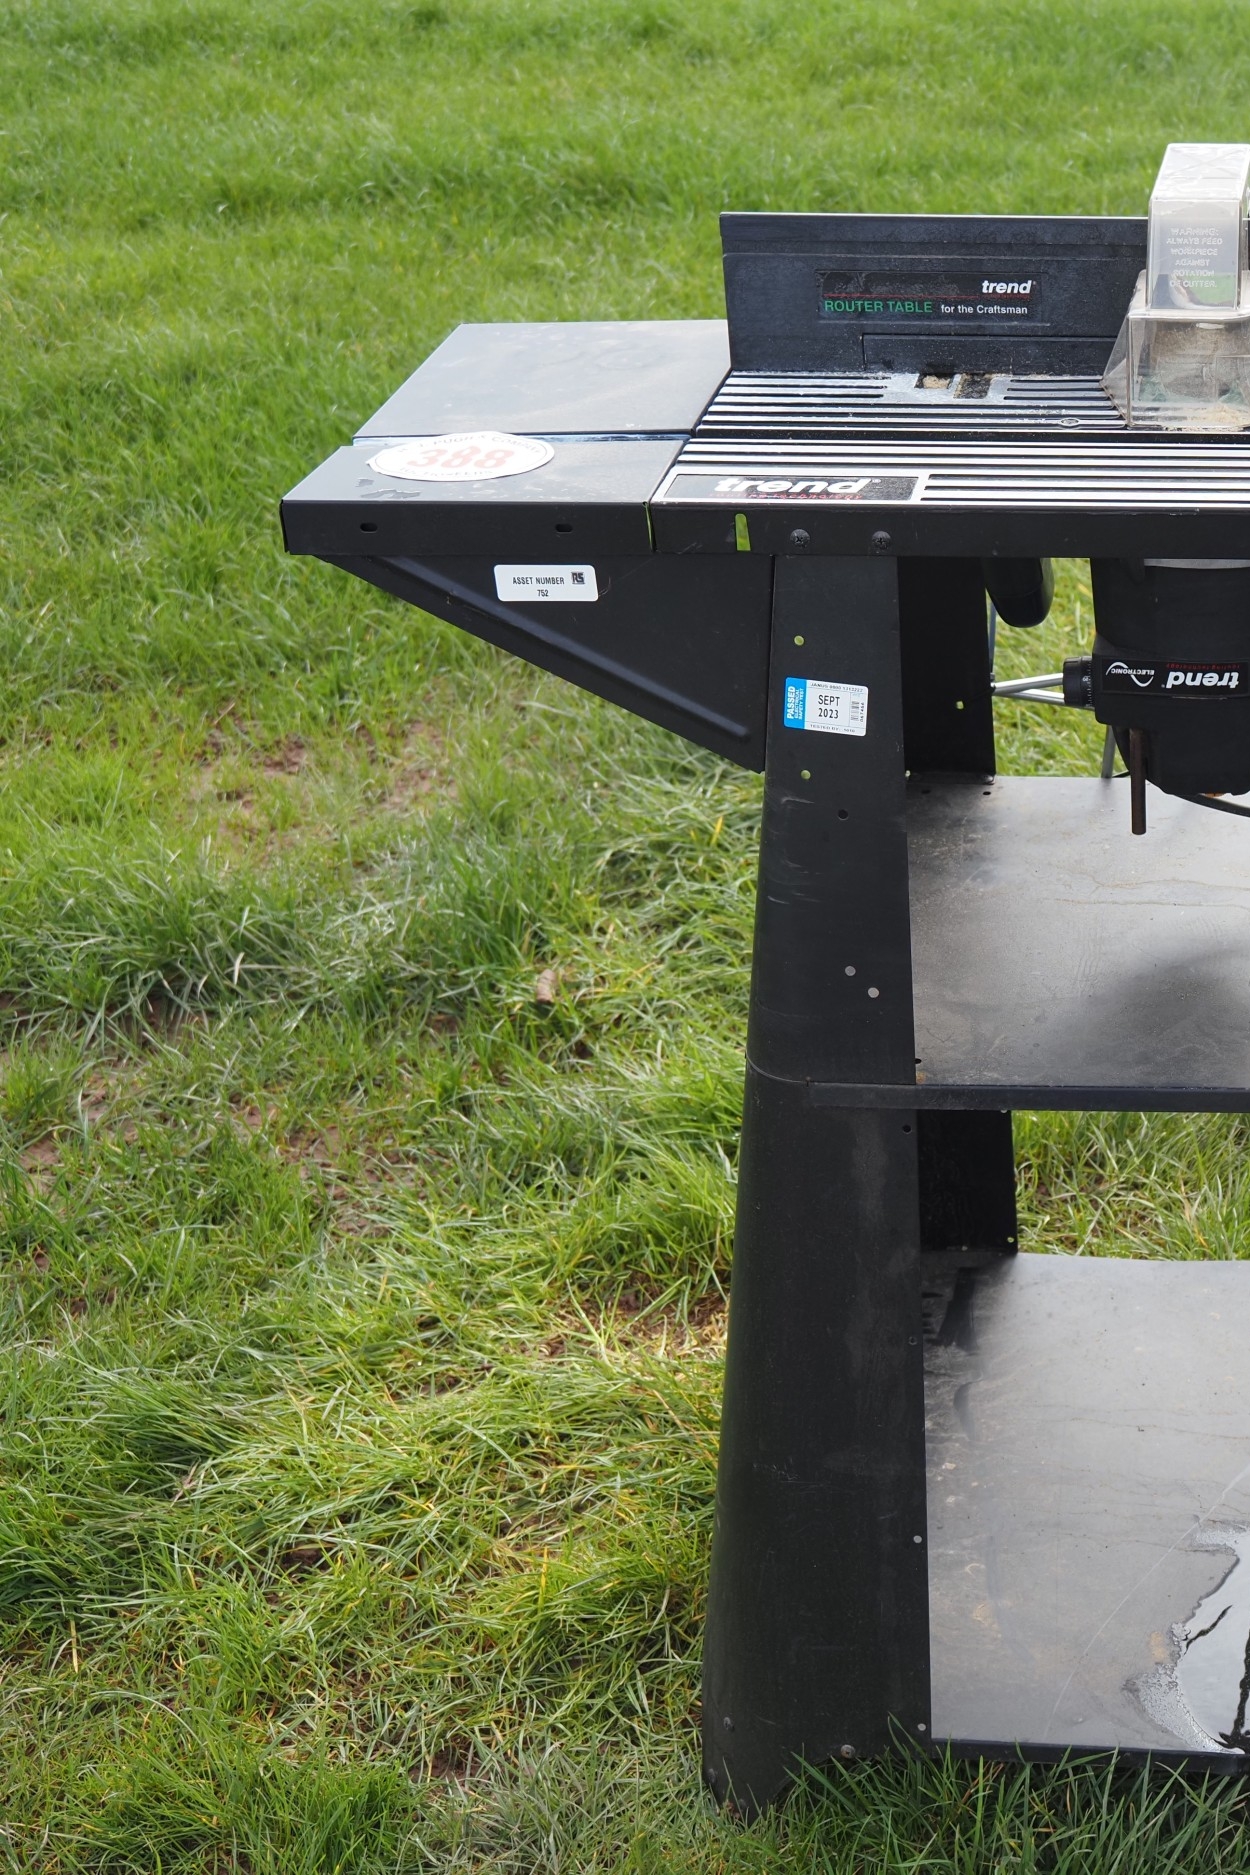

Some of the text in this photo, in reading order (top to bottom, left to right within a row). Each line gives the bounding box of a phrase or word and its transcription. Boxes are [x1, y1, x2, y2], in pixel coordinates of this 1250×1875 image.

[1173, 269, 1215, 277] ROTATION
[982, 280, 1032, 294] trend
[824, 300, 1028, 314] ROUTER TABLE for the Craftsman
[406, 446, 514, 469] 388
[1166, 671, 1240, 688] trend
[786, 686, 796, 720] PASSED
[818, 694, 840, 706] SEPT
[818, 708, 839, 719] 2023
